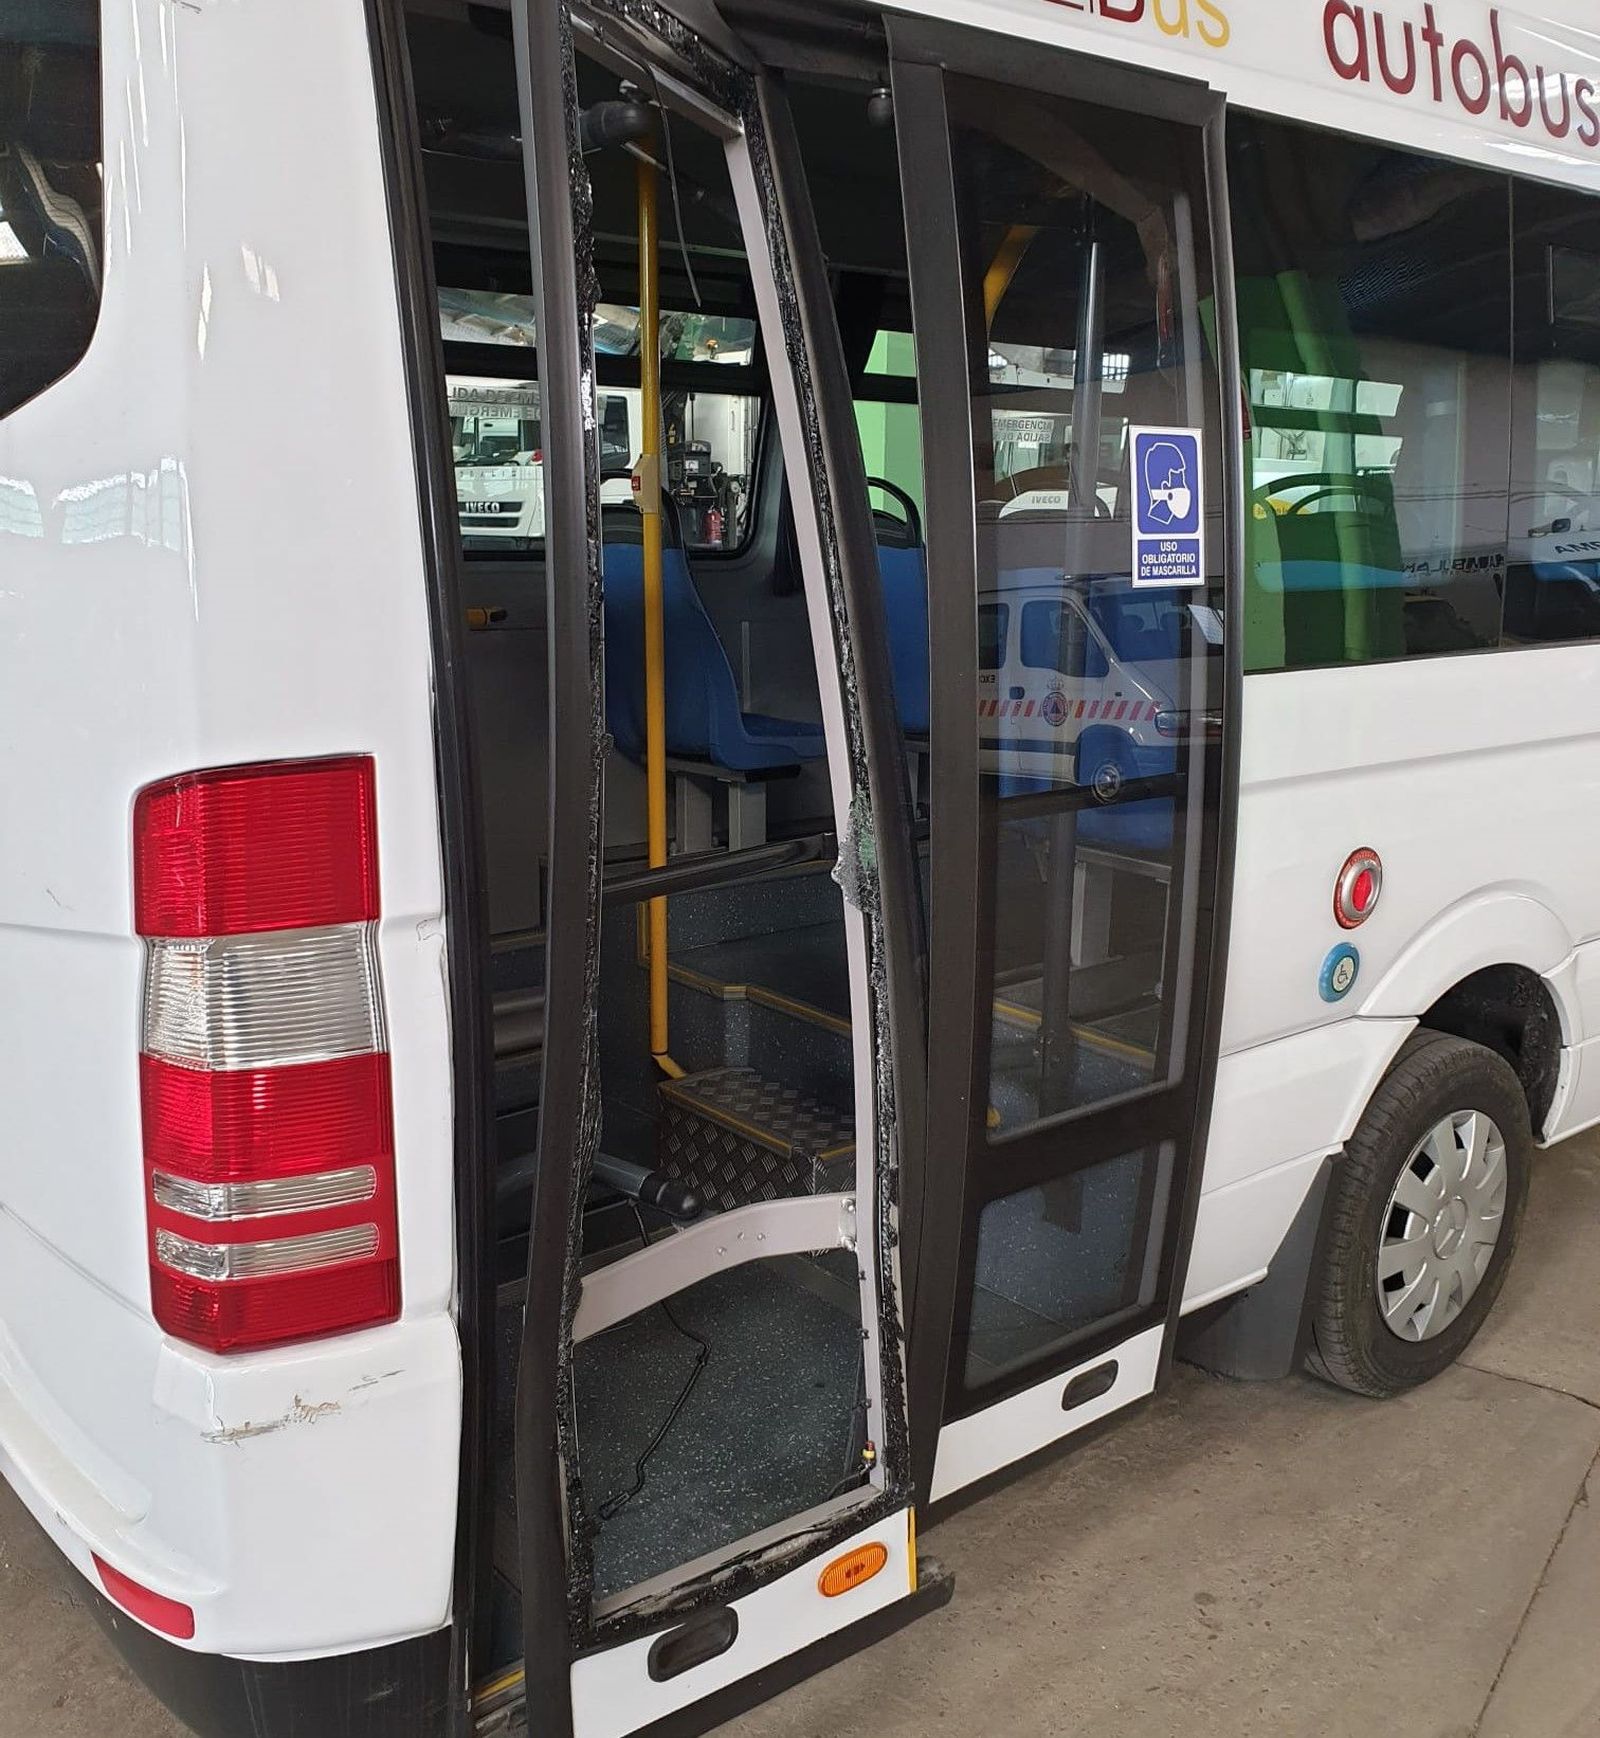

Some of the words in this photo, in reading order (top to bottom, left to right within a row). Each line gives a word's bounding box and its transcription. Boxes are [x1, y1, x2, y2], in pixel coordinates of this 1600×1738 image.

[1323, 0, 1600, 147] autobus
[1032, 495, 1062, 505] IVECO
[465, 502, 500, 513] IVECO
[1160, 541, 1178, 552] USO
[1142, 553, 1196, 565] OBLIGATORIO
[1141, 566, 1151, 577] DE
[1152, 565, 1197, 576] MASCARILLA
